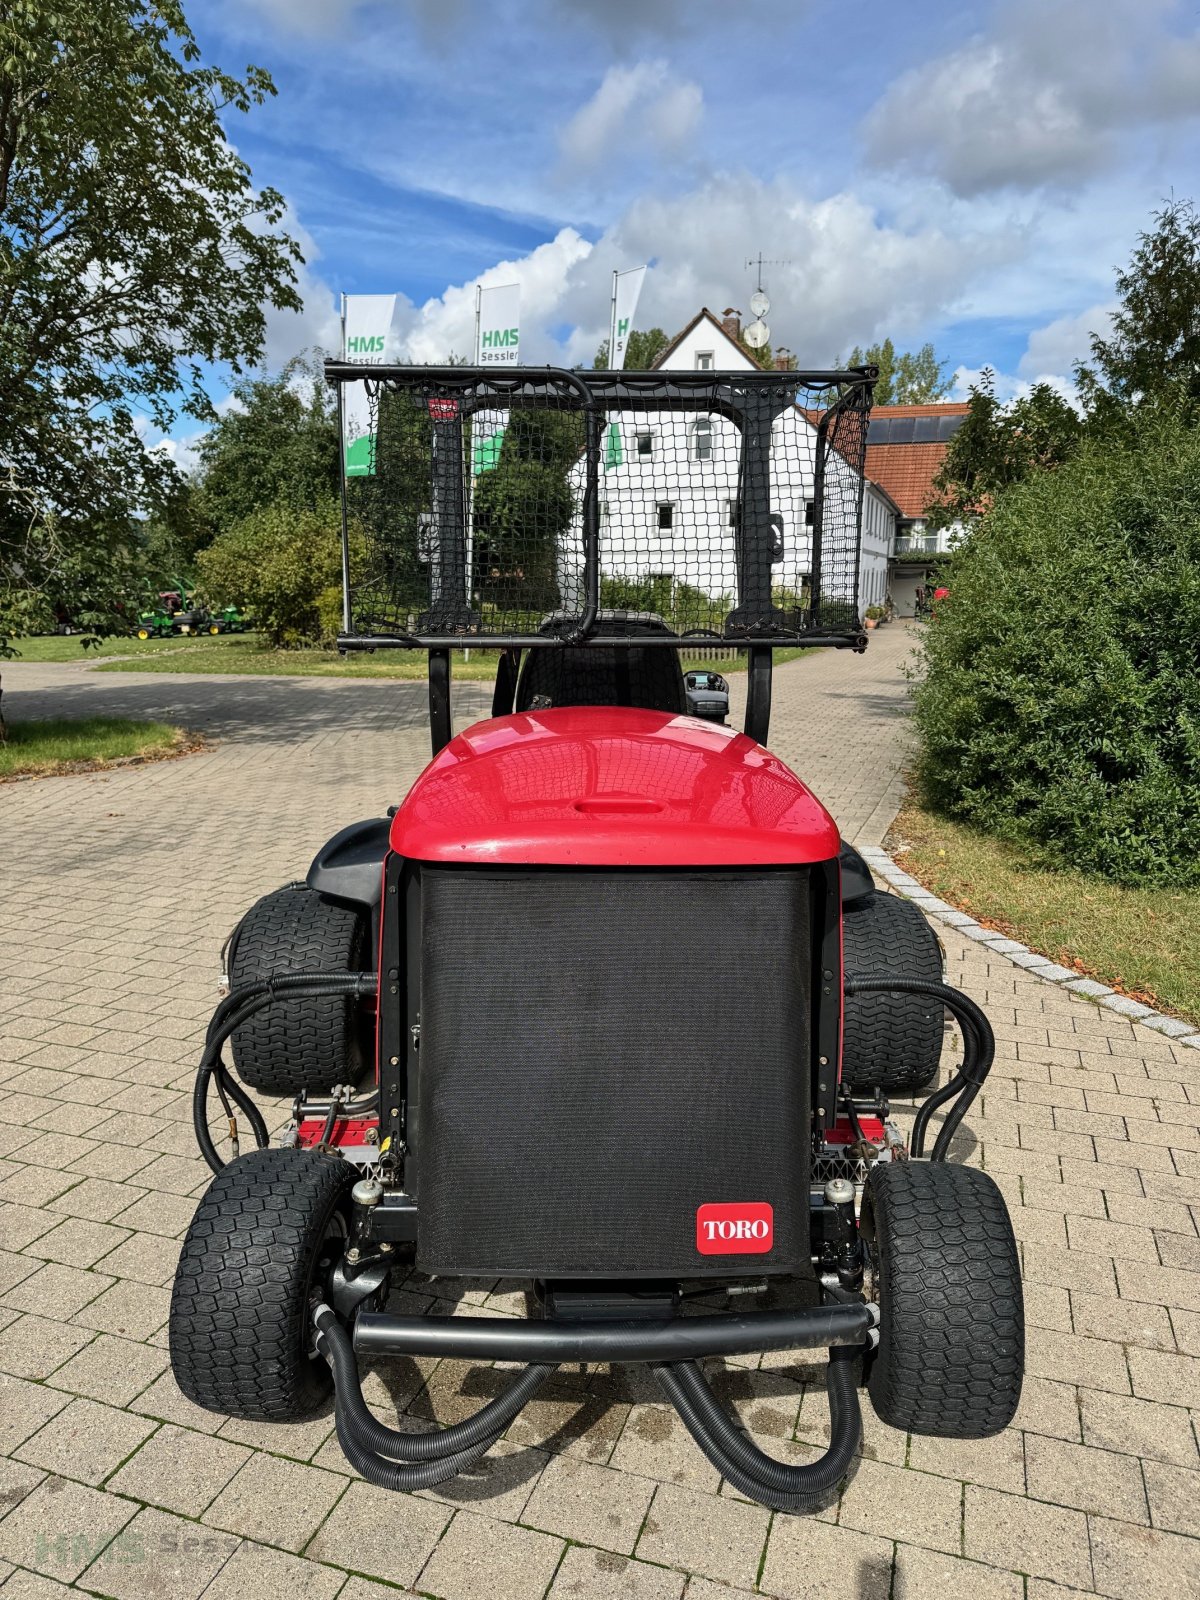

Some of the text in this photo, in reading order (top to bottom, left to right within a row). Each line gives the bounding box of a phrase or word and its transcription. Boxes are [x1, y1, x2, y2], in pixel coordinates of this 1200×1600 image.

[347, 335, 385, 353] HMS
[482, 328, 519, 348] HMS
[481, 351, 518, 362] Sessler
[703, 1219, 769, 1240] TORO
